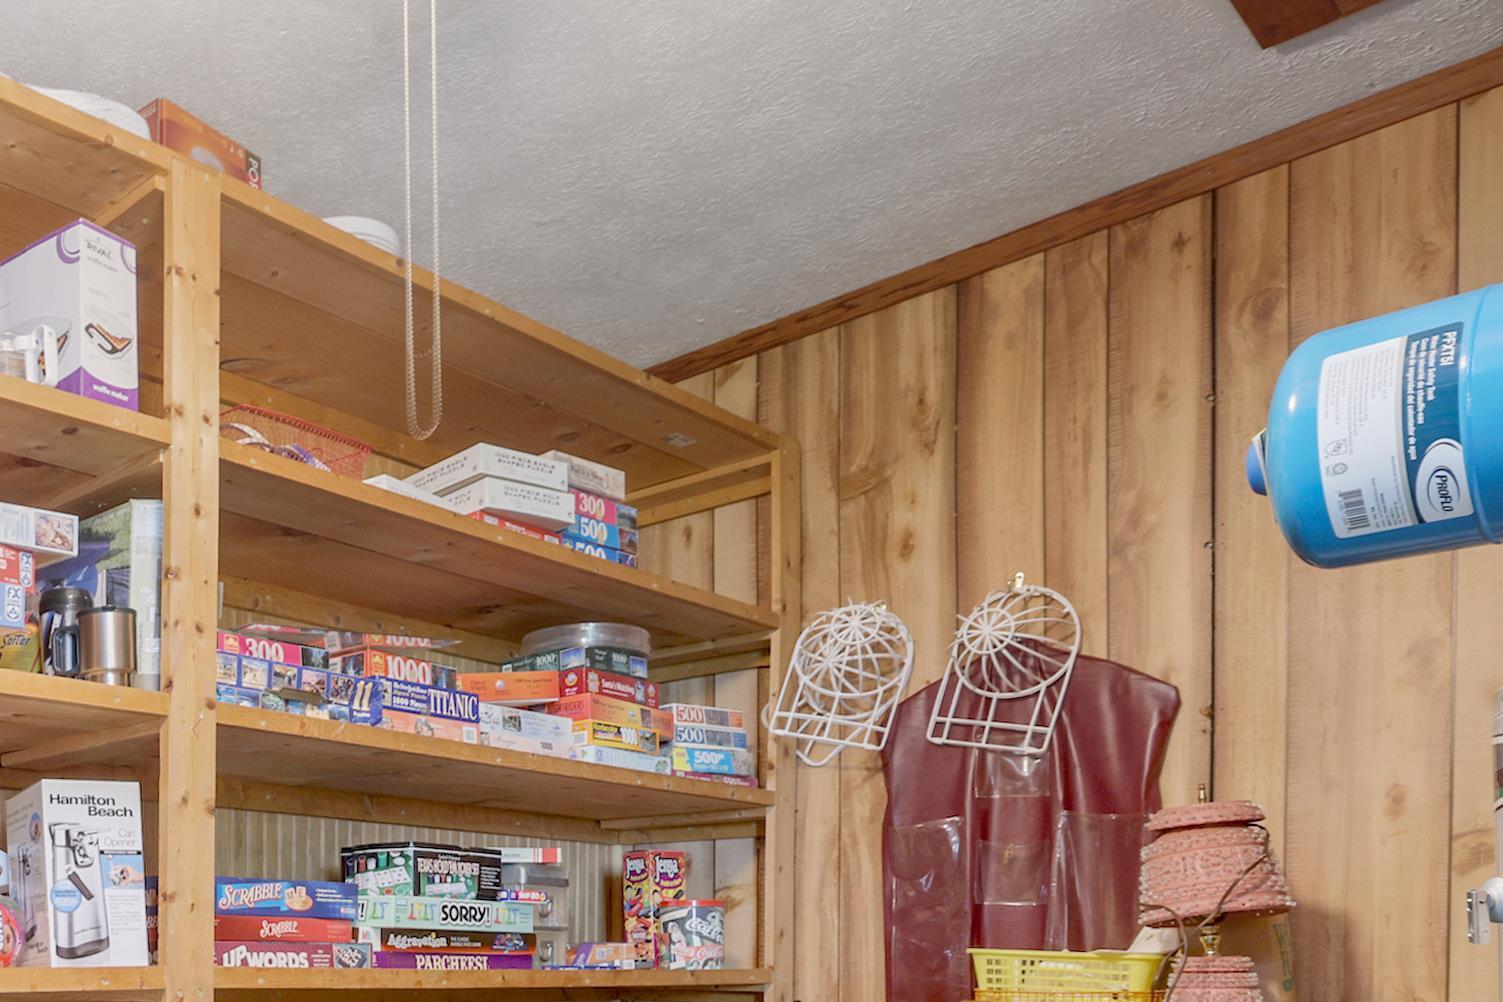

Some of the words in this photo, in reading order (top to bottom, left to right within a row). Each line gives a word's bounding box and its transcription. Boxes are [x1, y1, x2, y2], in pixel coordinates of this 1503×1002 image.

[86, 241, 113, 260] RIVAL
[579, 493, 605, 518] 300
[580, 517, 608, 546] 500
[245, 637, 284, 665] 300
[387, 655, 432, 686] 1000
[428, 688, 478, 720] TITANIC
[677, 706, 704, 724] 500
[676, 727, 704, 744] 500
[50, 793, 116, 807] Hamilton
[89, 806, 133, 818] Beach
[119, 827, 136, 838] Can
[104, 837, 136, 849] Opener
[654, 854, 680, 883] Jenga
[218, 881, 283, 910] SCRABBLE
[440, 904, 491, 924] SORRY!
[260, 919, 299, 939] SCRABBLE
[386, 932, 448, 951] Aggravation
[222, 945, 309, 968] UPWORDS
[414, 954, 489, 970] PARCHEESI
